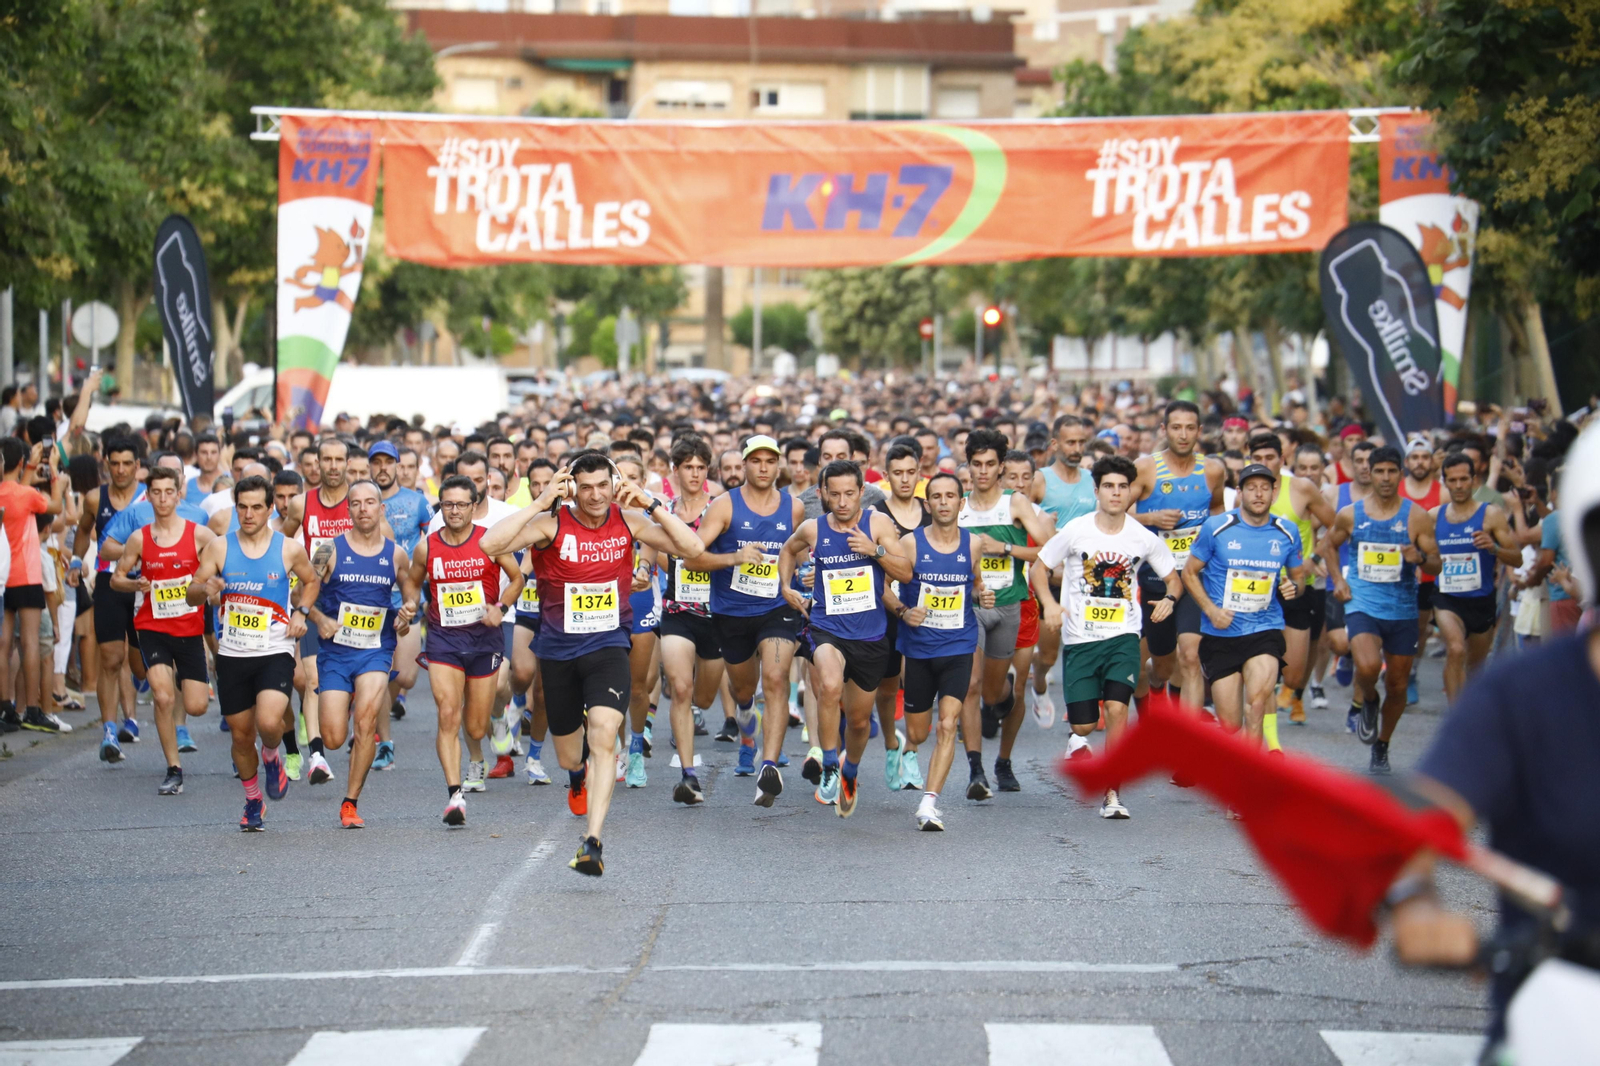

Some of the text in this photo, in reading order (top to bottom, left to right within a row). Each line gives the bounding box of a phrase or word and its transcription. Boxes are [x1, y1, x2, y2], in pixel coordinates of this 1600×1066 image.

[437, 137, 521, 169] #SOY
[1096, 136, 1181, 169] #SOY
[427, 162, 578, 215] TROTA
[1085, 158, 1238, 217] TROTA
[475, 199, 652, 252] CALLES
[1131, 190, 1313, 250] CALLES
[983, 558, 1005, 570] 361
[1227, 558, 1281, 569] TROTASIERRA
[1377, 553, 1384, 564] 9
[747, 563, 771, 576] 260
[1445, 562, 1474, 574] 2778
[339, 573, 391, 586] TROTASIERRA
[687, 571, 710, 582] 450
[845, 579, 854, 592] 2
[1247, 581, 1256, 592] 4
[449, 592, 473, 605] 103
[576, 594, 612, 609] 1374
[931, 597, 956, 608] 317
[1092, 607, 1116, 620] 997
[235, 614, 259, 628] 198
[350, 615, 375, 628] 816
